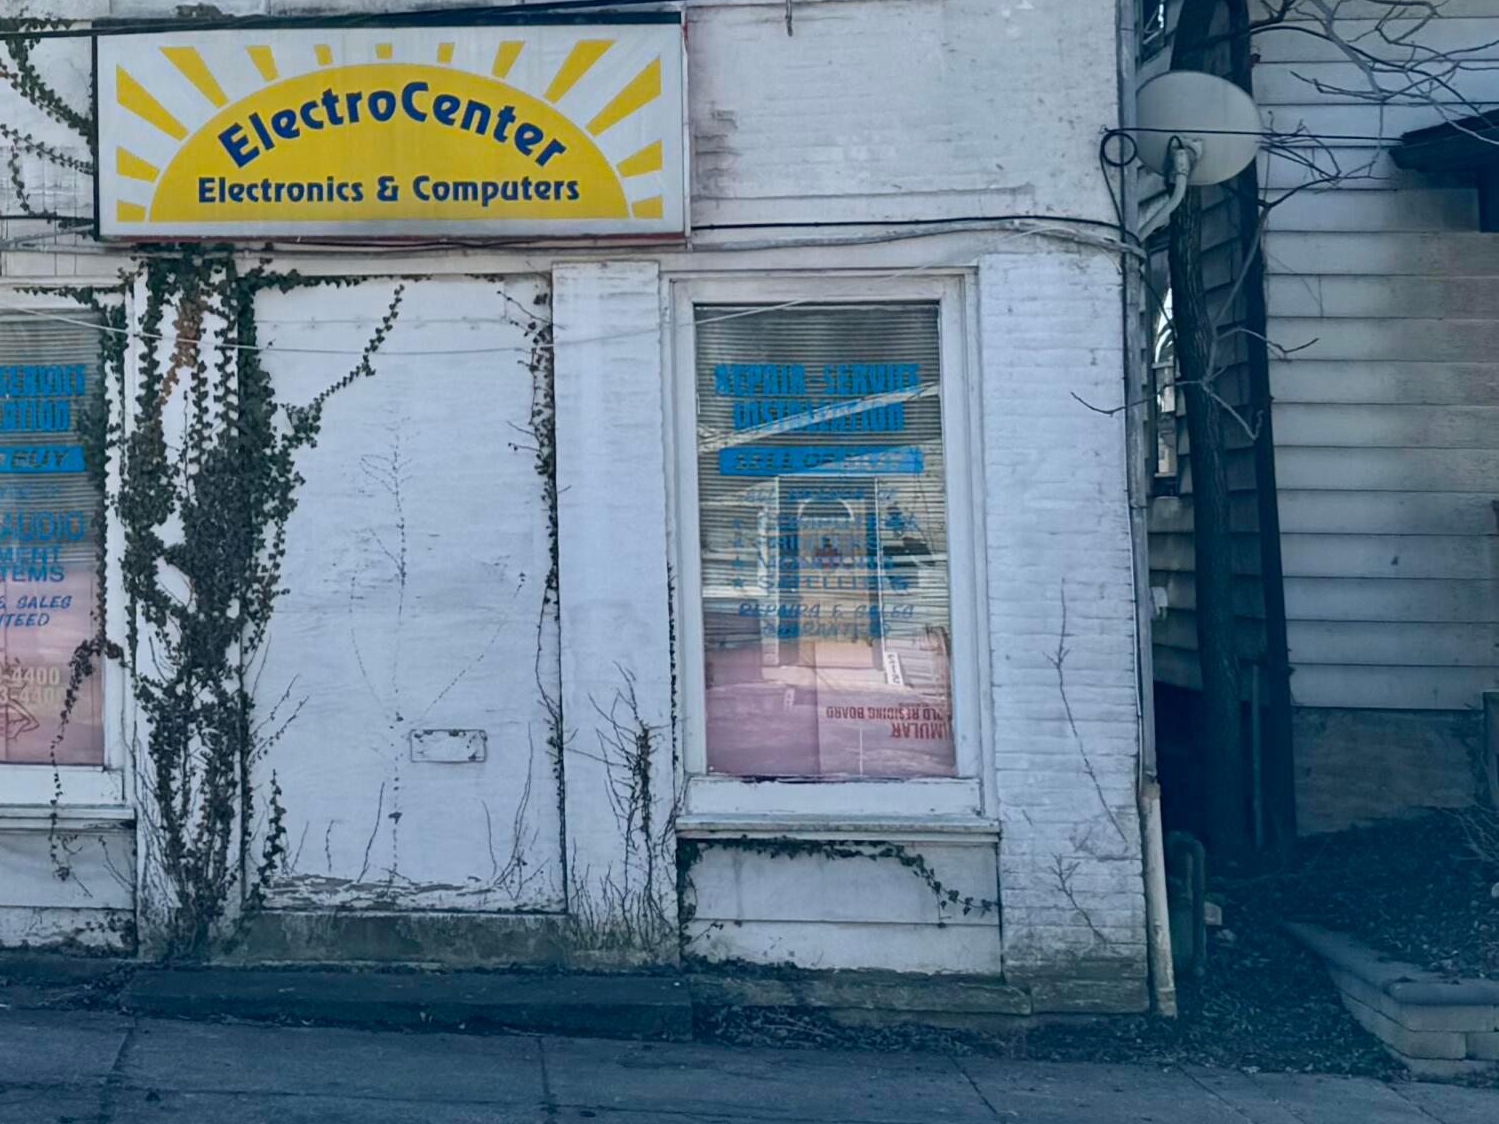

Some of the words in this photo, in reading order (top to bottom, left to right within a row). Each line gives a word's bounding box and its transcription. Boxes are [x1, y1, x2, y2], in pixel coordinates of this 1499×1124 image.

[218, 81, 567, 168] ElectroCenter
[198, 176, 364, 203] Electronics
[377, 176, 399, 202] &
[412, 175, 580, 207] Computers
[12, 449, 68, 470] BUY
[18, 596, 72, 610] SALES
[826, 706, 865, 720] BOARD
